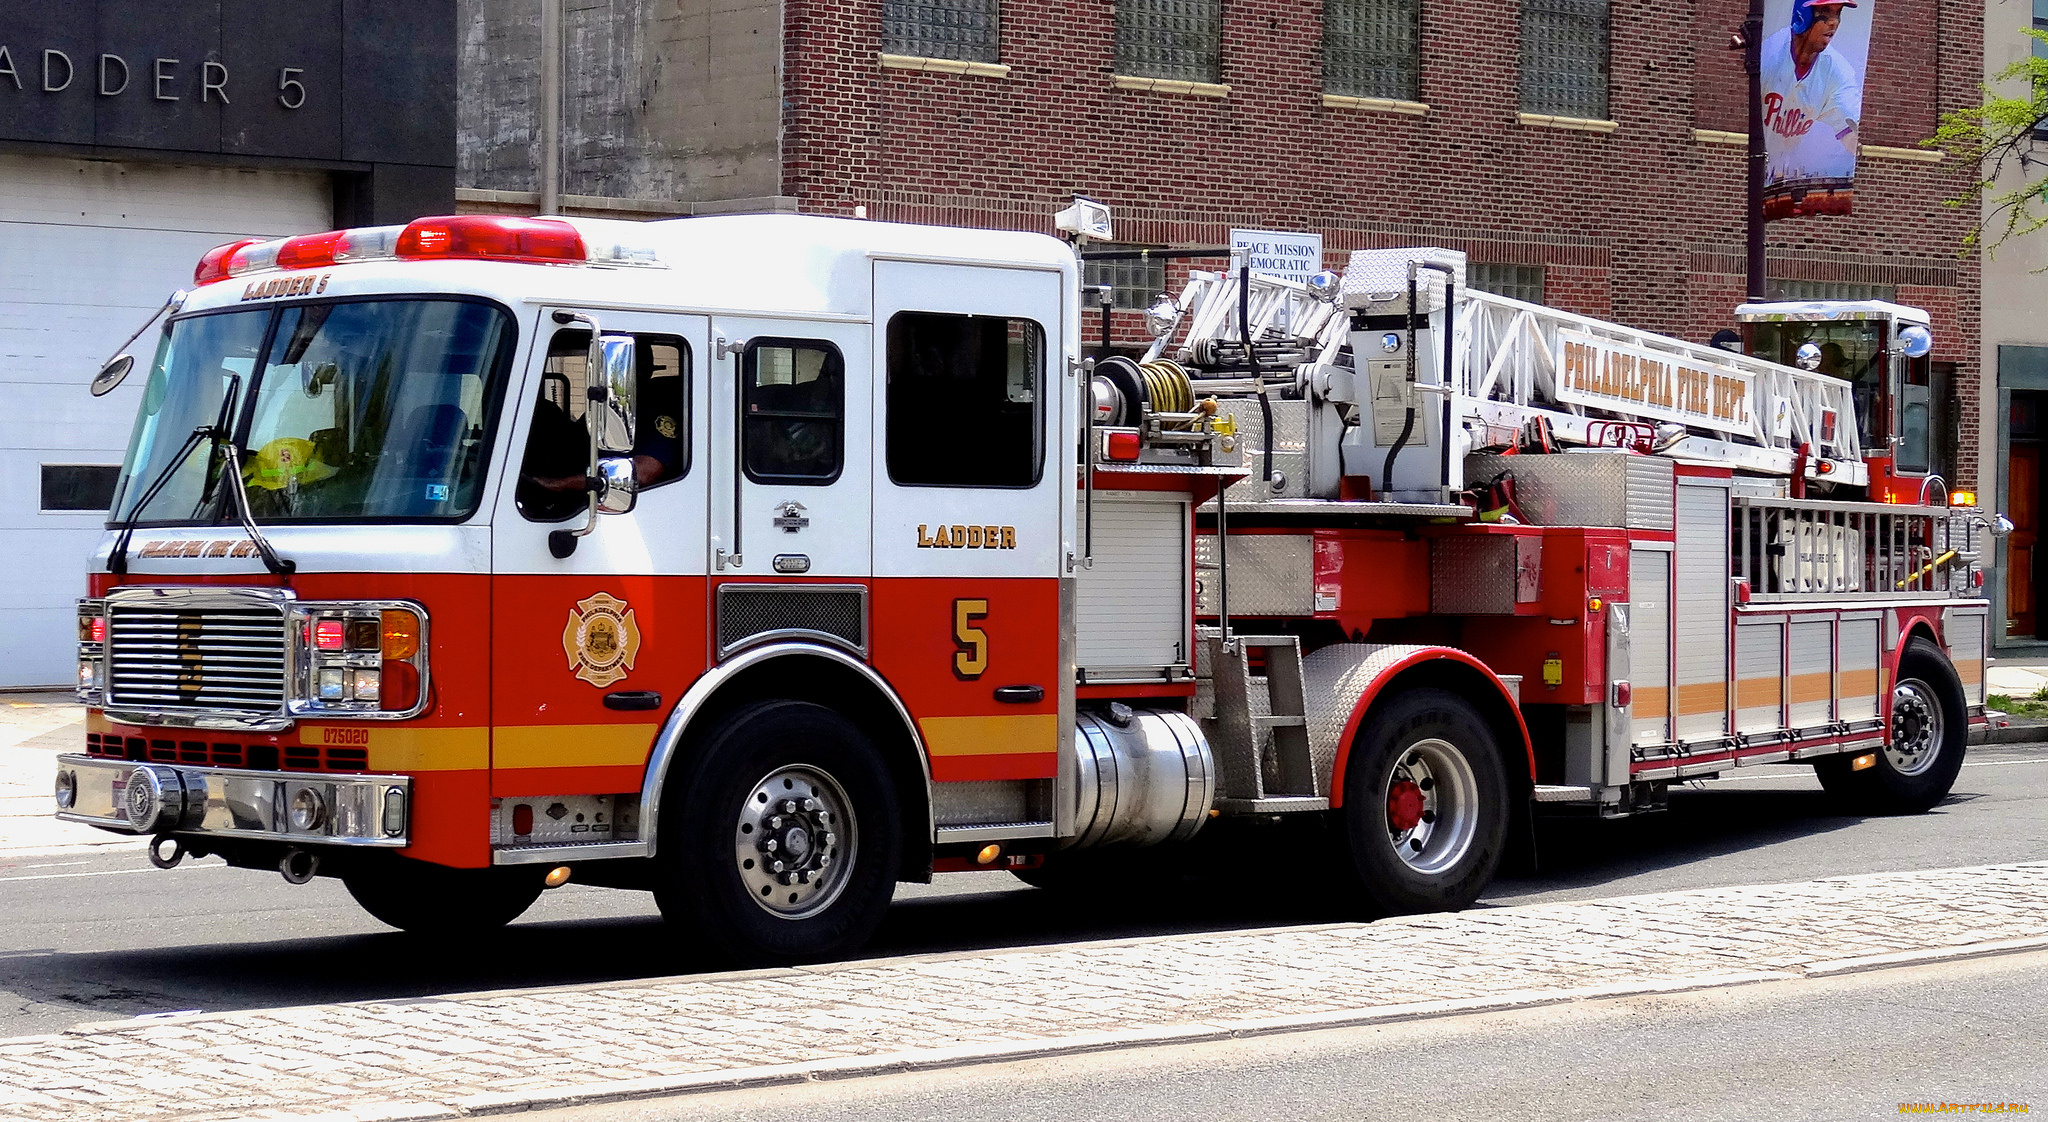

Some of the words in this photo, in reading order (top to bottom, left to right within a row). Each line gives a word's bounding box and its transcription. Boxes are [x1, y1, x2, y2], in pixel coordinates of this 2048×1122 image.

[277, 67, 306, 109] 5
[1274, 243, 1315, 257] MISSION
[1250, 257, 1311, 271] EMOCRATIC
[241, 274, 317, 301] LADDER
[316, 273, 332, 294] 5
[1564, 341, 1673, 410] PHILADELPHIA
[1676, 366, 1709, 417] FIRE
[1712, 374, 1749, 425] DEPT.
[917, 524, 1017, 549] LADDER
[581, 607, 622, 623] PHILADELPHIA
[952, 598, 988, 682] 5
[589, 651, 625, 672] DEPARTMENT
[323, 728, 369, 744] 075020
